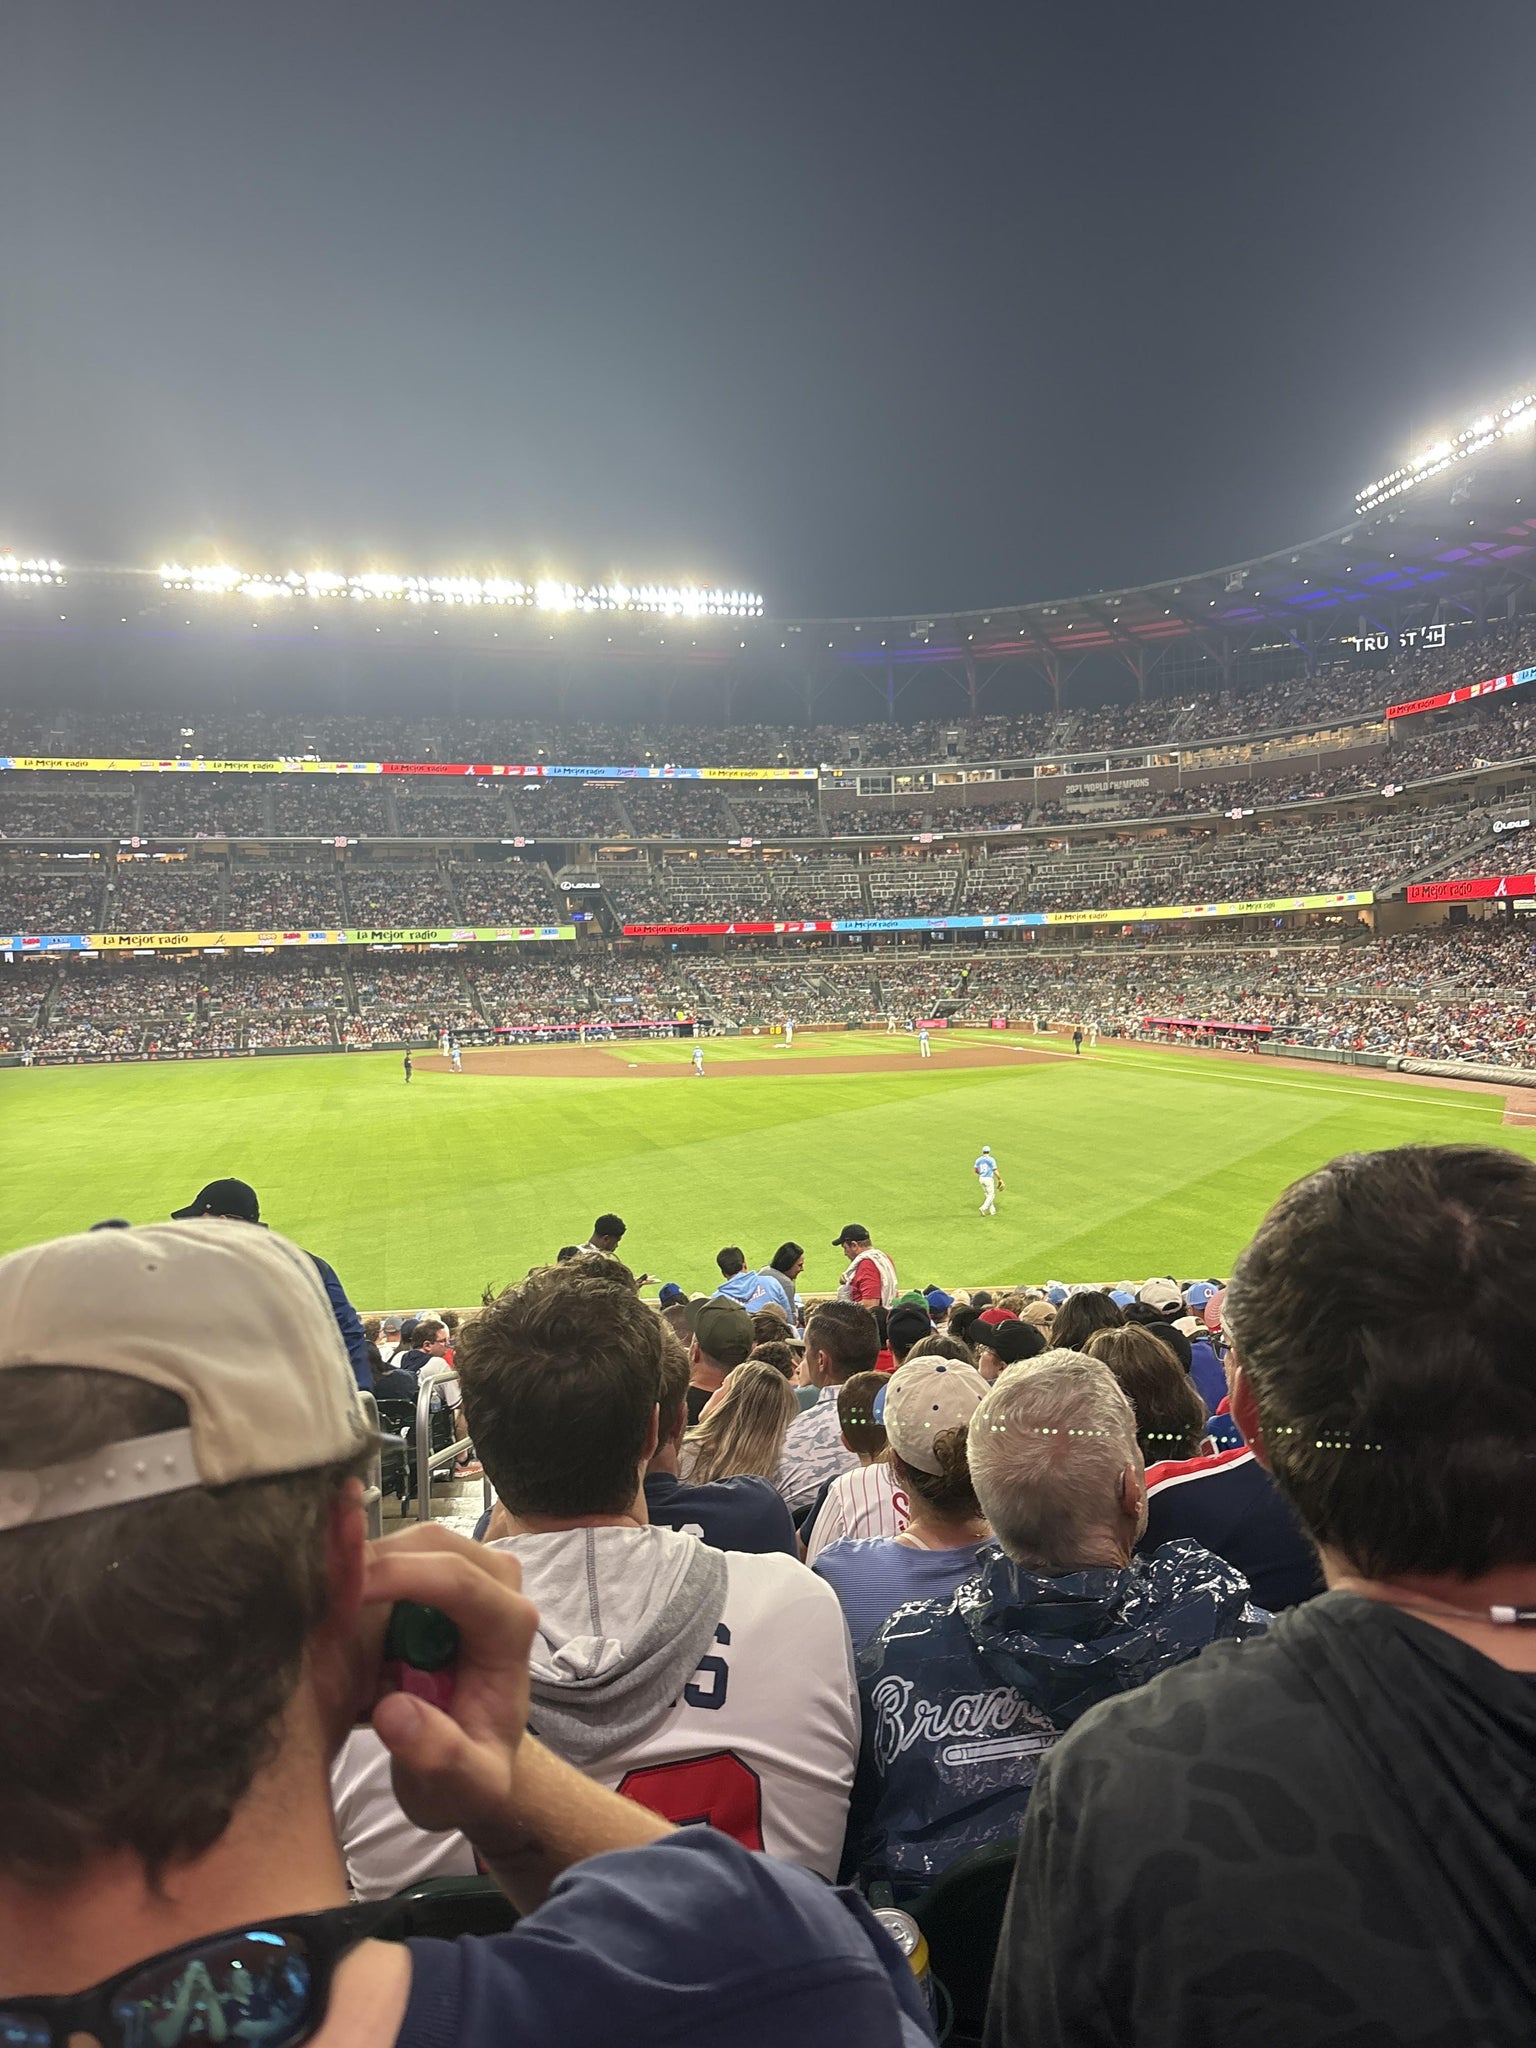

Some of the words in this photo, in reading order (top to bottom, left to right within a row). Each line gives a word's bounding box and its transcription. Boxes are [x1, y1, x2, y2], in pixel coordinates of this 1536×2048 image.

[118, 936, 154, 946] Mejor
[158, 934, 188, 945] radio
[371, 930, 405, 943] Mejor
[409, 929, 437, 940] radio
